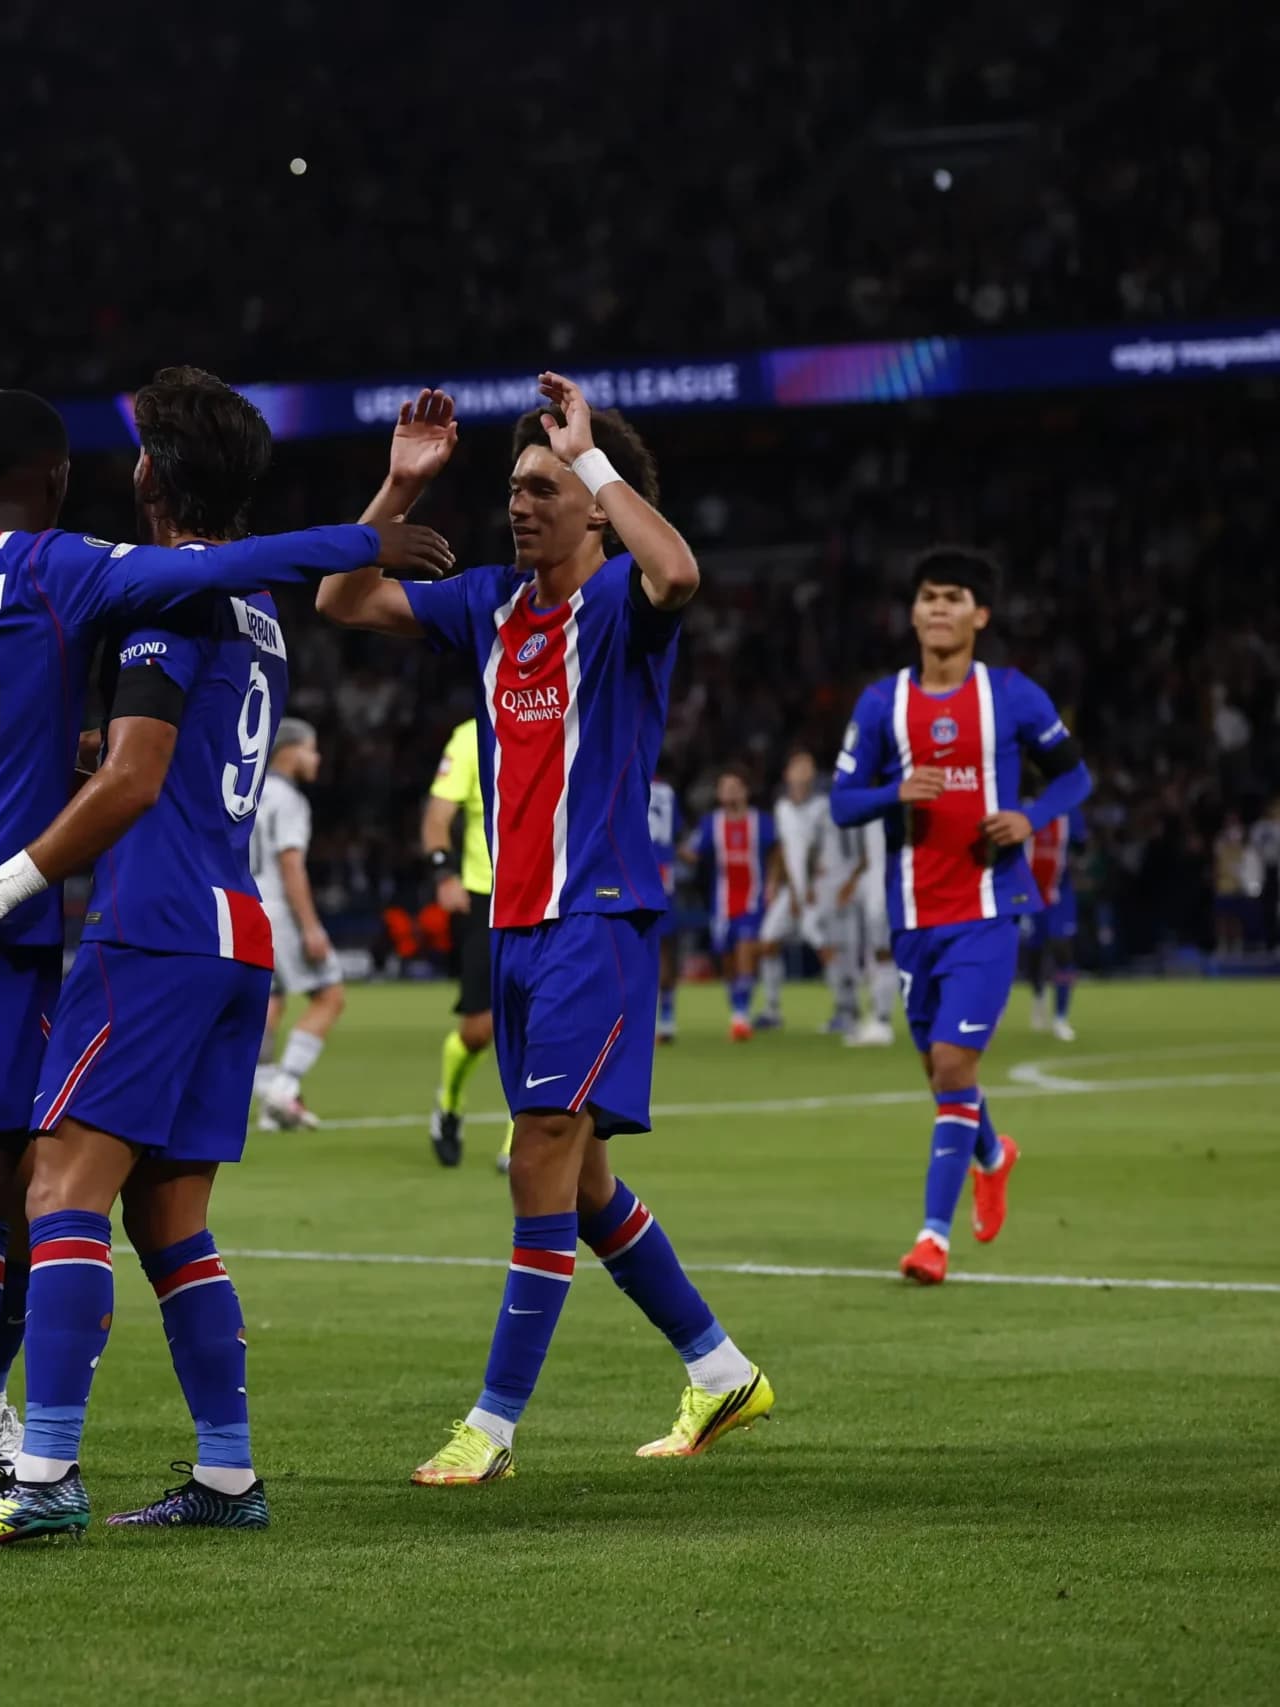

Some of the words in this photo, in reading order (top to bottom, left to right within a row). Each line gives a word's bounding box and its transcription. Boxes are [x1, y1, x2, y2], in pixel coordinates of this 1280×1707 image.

[623, 362, 738, 407] LEAGUE
[501, 686, 561, 714] QATAR
[516, 706, 562, 722] AIRWAYS
[222, 661, 273, 823] 9
